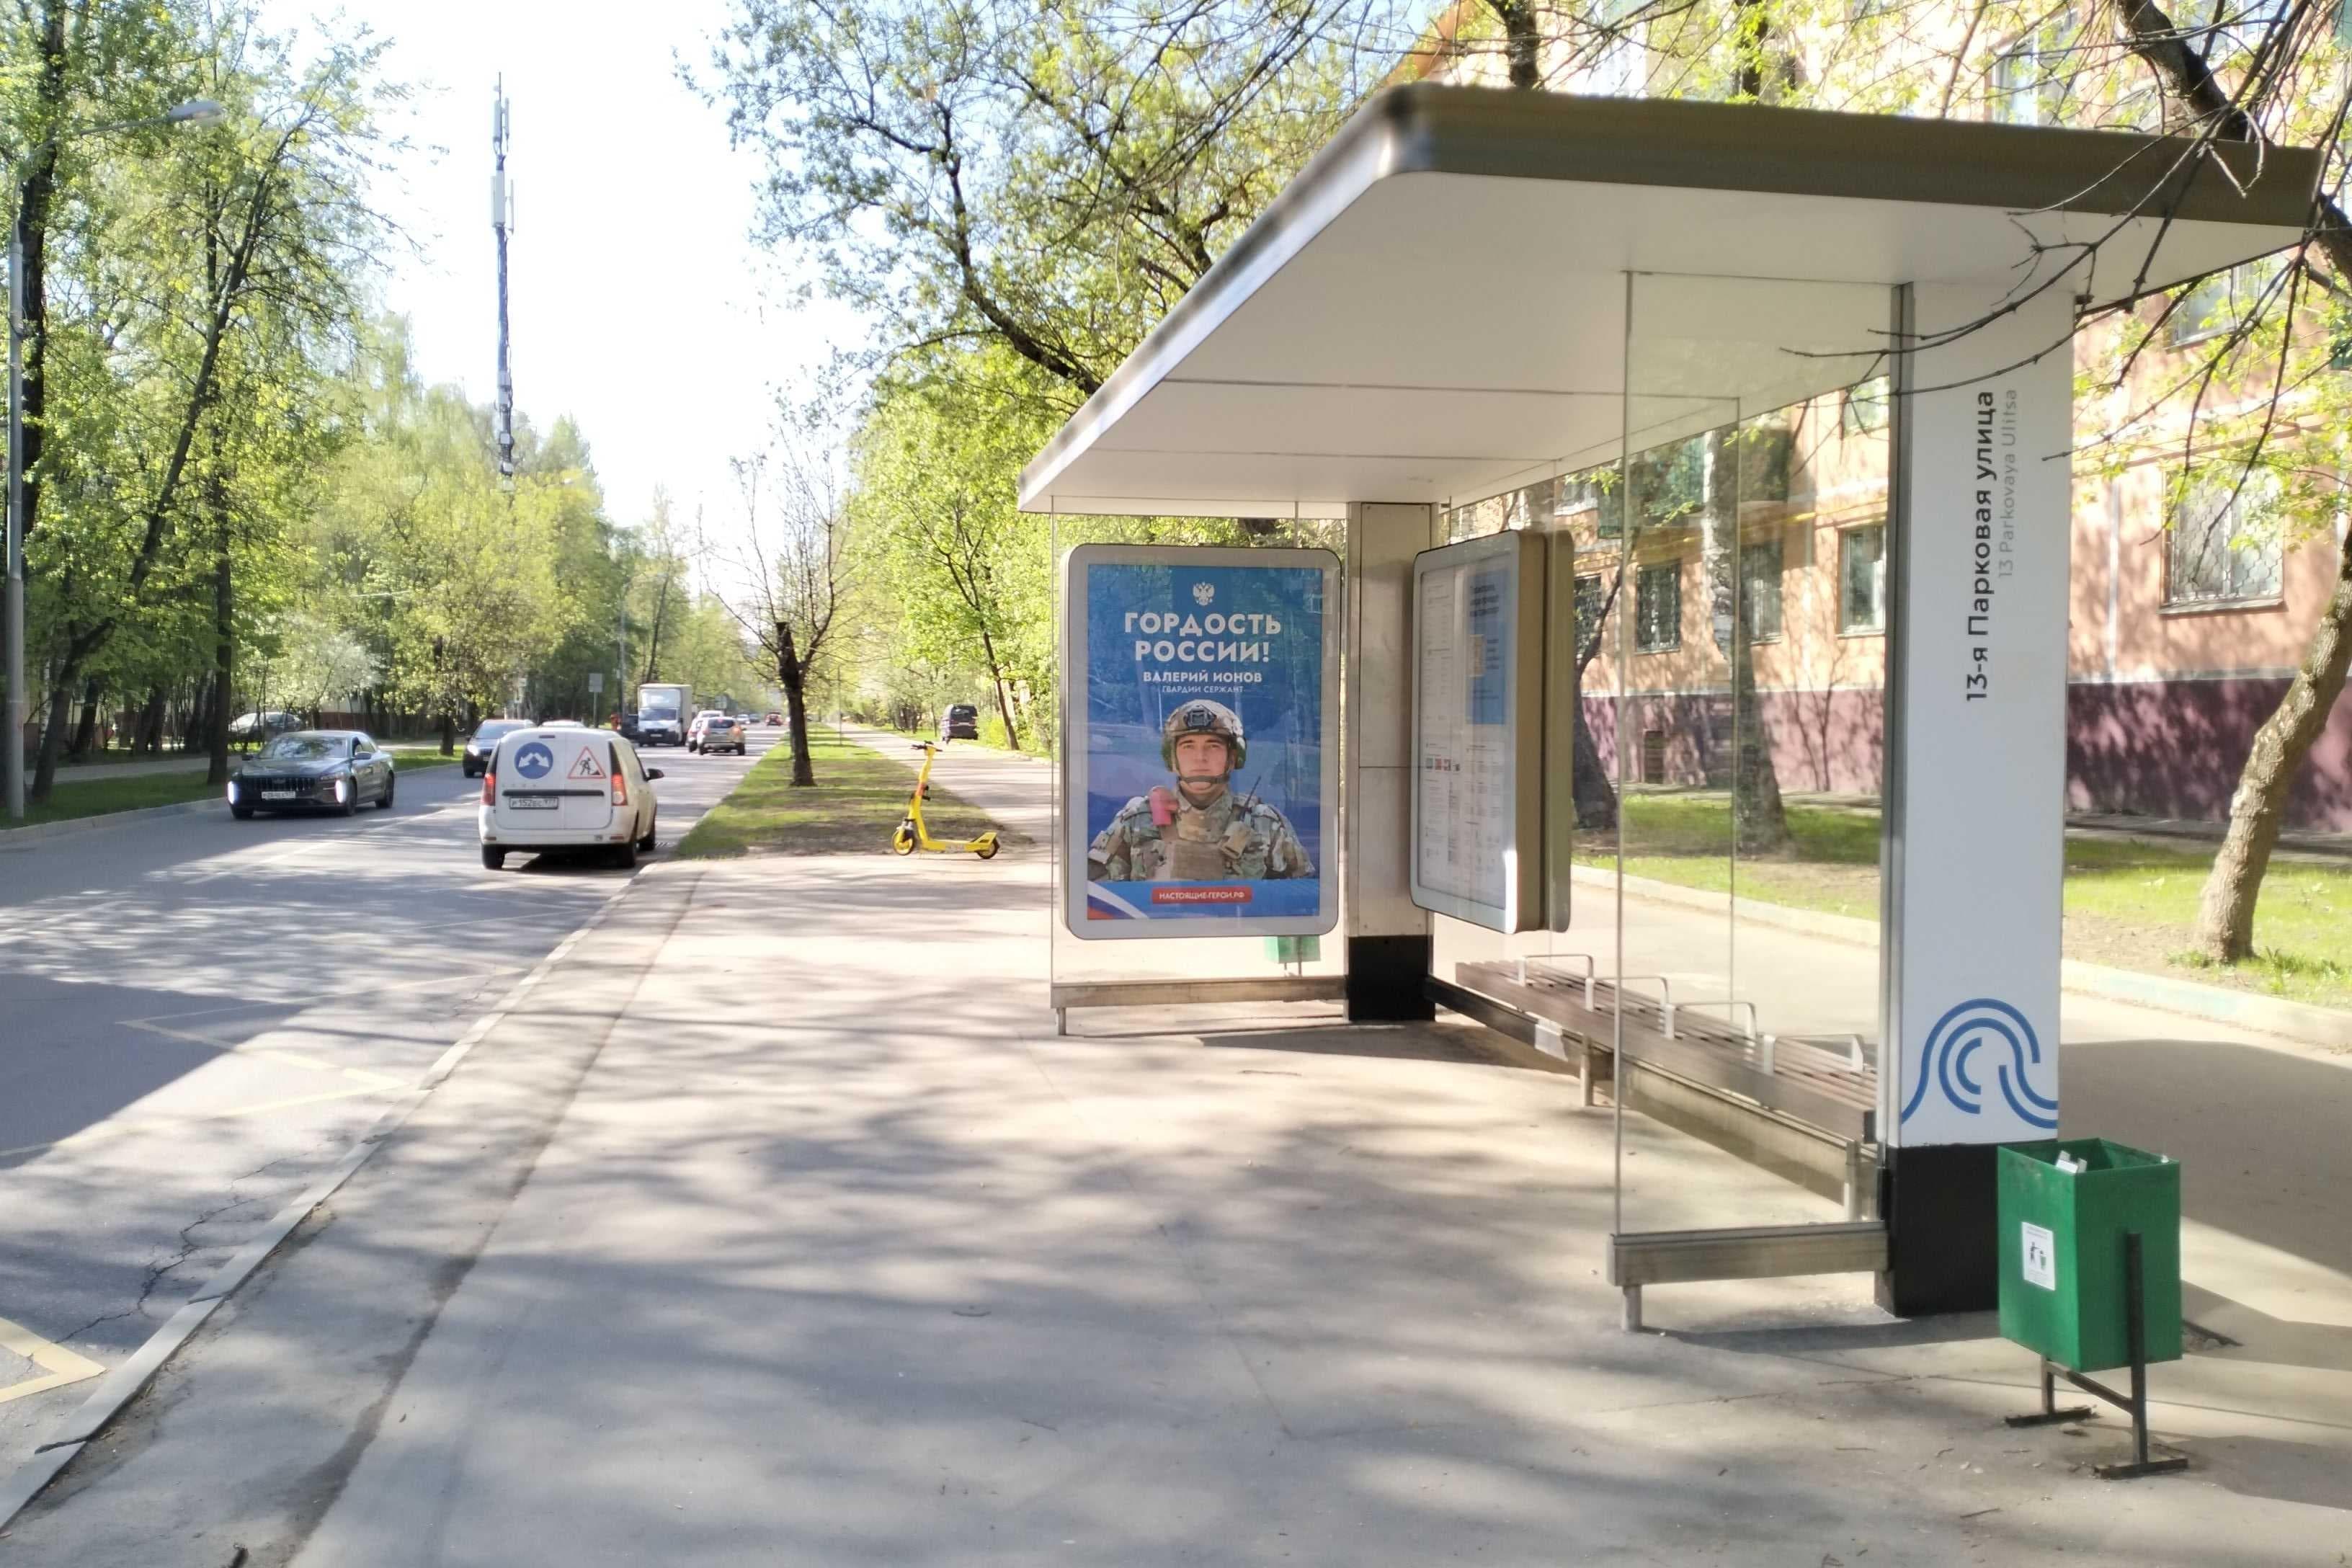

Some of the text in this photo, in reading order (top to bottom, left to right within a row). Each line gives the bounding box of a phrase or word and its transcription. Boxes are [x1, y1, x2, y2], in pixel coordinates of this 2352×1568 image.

[1999, 390, 2018, 578] 13 Parkovaya Ulitsa
[1966, 391, 1997, 701] 13-я Парковая улица
[1125, 612, 1281, 636] ГОРДОСТЬ
[1136, 641, 1269, 662] РОССИИ!
[1143, 669, 1263, 682] ВАЛЕРИЙ ИОНОВ
[1162, 685, 1244, 694] ГВАРДИИ СЕРЖАНТ
